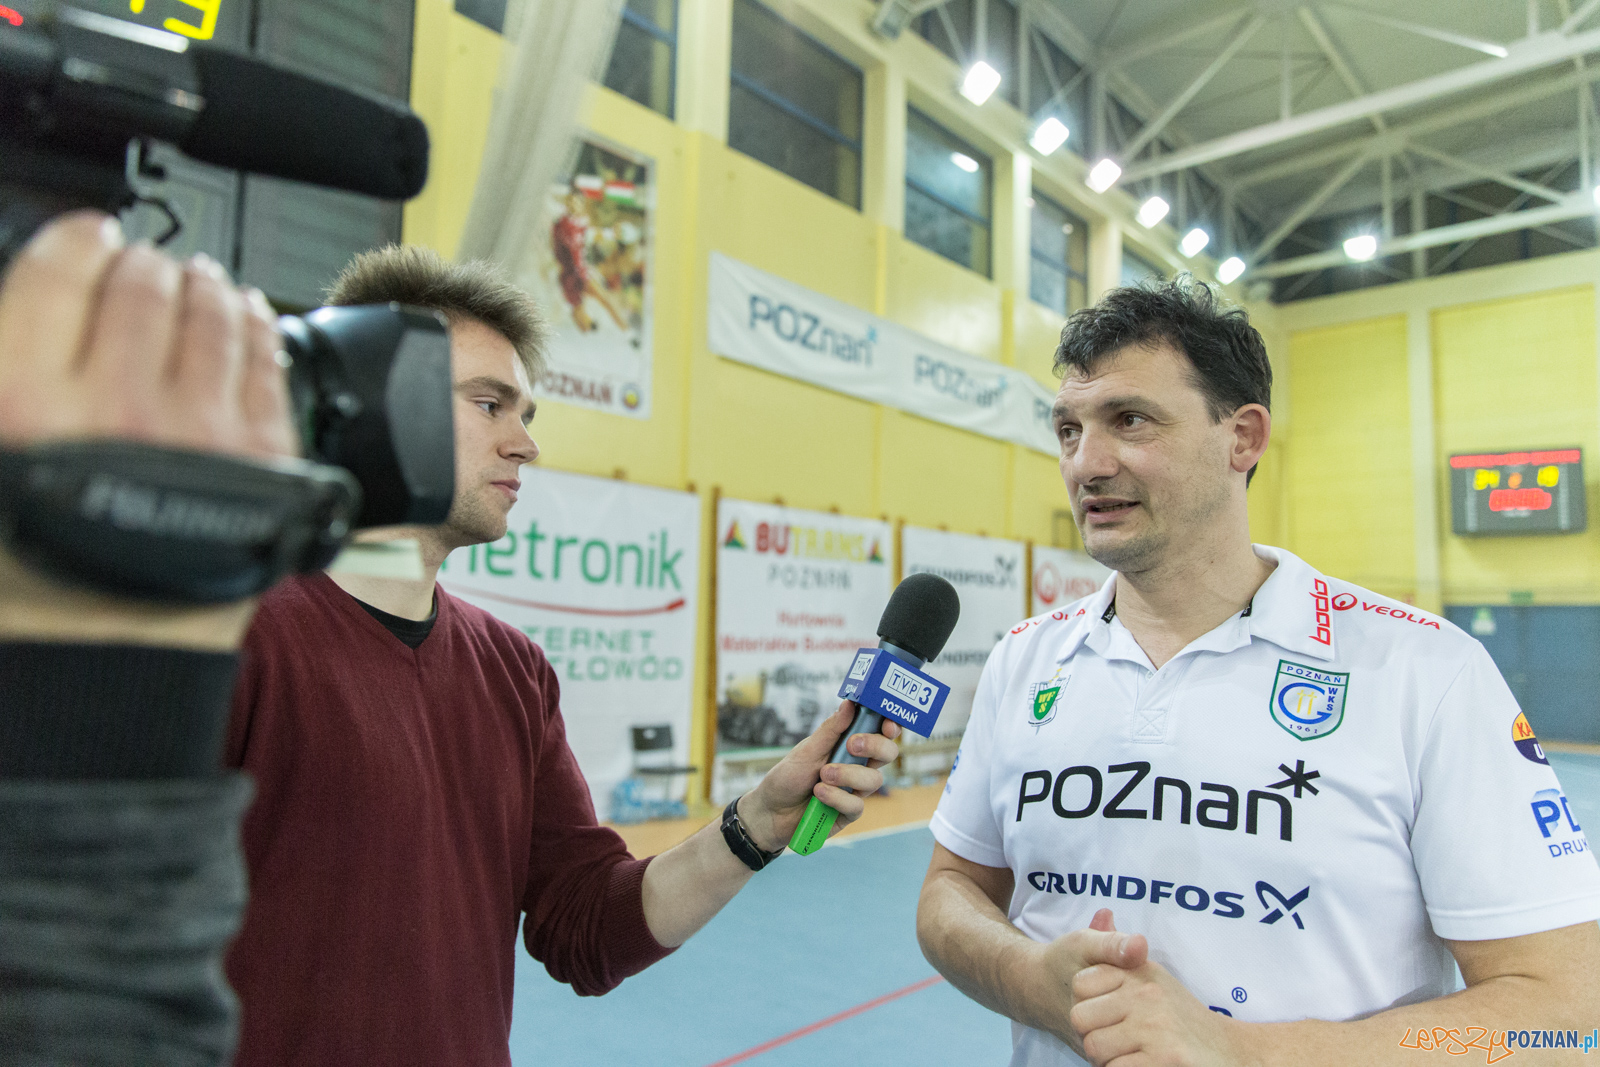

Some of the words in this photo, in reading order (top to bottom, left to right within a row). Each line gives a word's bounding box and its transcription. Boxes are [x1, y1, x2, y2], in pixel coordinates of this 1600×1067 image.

[1362, 601, 1440, 630] VEOLIA
[880, 698, 919, 726] POZNAŃ
[1027, 871, 1245, 919] GRUNDFOS
